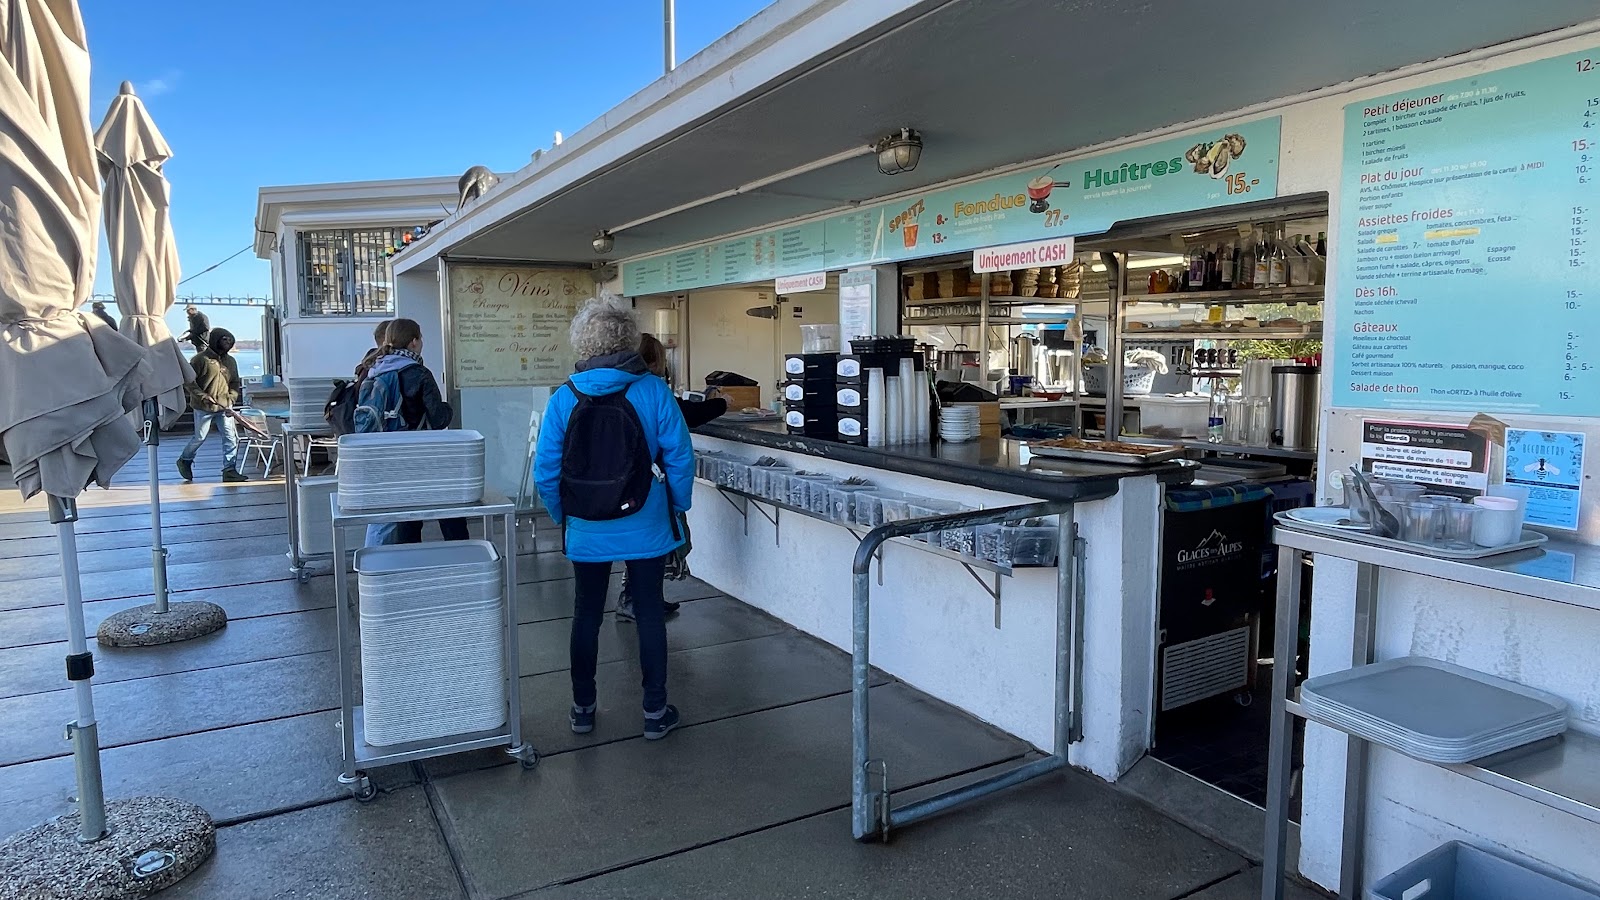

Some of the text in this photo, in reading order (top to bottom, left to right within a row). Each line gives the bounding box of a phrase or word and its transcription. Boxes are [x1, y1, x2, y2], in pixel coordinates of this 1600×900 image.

[1363, 93, 1444, 118] Petit déjeuner
[1363, 118, 1387, 127] Complet
[1395, 112, 1417, 121] bircher
[1427, 106, 1448, 115] salade
[1483, 97, 1494, 105] jus
[1367, 116, 1443, 136] tartines, boisson chaude
[1572, 139, 1596, 151] 15.-
[1365, 148, 1386, 156] bircher
[1364, 157, 1383, 165] salade
[1084, 157, 1182, 190] Huîtres
[1360, 166, 1424, 184] Plat du jour
[1409, 178, 1433, 187] Hospice
[1446, 172, 1482, 182] présentation
[1527, 161, 1545, 170] MIDI
[1575, 164, 1592, 174] 10.-
[1225, 172, 1260, 195] 15.-
[1579, 175, 1591, 184] 6.-
[1127, 184, 1151, 193] journée
[954, 194, 1026, 218] Fondue
[1572, 206, 1588, 214] 15.-
[889, 199, 925, 233] SPRITZ
[937, 214, 948, 226] 8.-
[1044, 208, 1069, 227] 27.-
[1358, 208, 1453, 228] Assiettes froides
[1572, 217, 1588, 225] 15.-
[1426, 222, 1454, 230] tomates,
[1454, 217, 1496, 227] concombres,
[1570, 227, 1587, 235] 15.-
[932, 232, 947, 244] 13.-
[979, 244, 1066, 271] Uniquement CASH
[1432, 250, 1460, 258] arrivage)
[1486, 245, 1516, 254] Espagne
[1570, 248, 1586, 256] 15.-
[1444, 259, 1470, 267] oignons
[1568, 259, 1585, 267] 15.-
[498, 270, 551, 297] Vins
[778, 276, 823, 290] Uniquement CASH
[1355, 286, 1398, 298] Dès 16h.
[1567, 290, 1583, 298] 15.-
[473, 299, 510, 312] Rouges
[1354, 322, 1398, 333] Gâteaux
[509, 341, 537, 352] Verre
[1350, 383, 1380, 392] Salade
[1383, 384, 1394, 393] de
[1396, 384, 1419, 393] thon
[1559, 392, 1574, 400] 15.-
[1178, 548, 1210, 562] GLACES
[1218, 542, 1242, 556] ALPES
